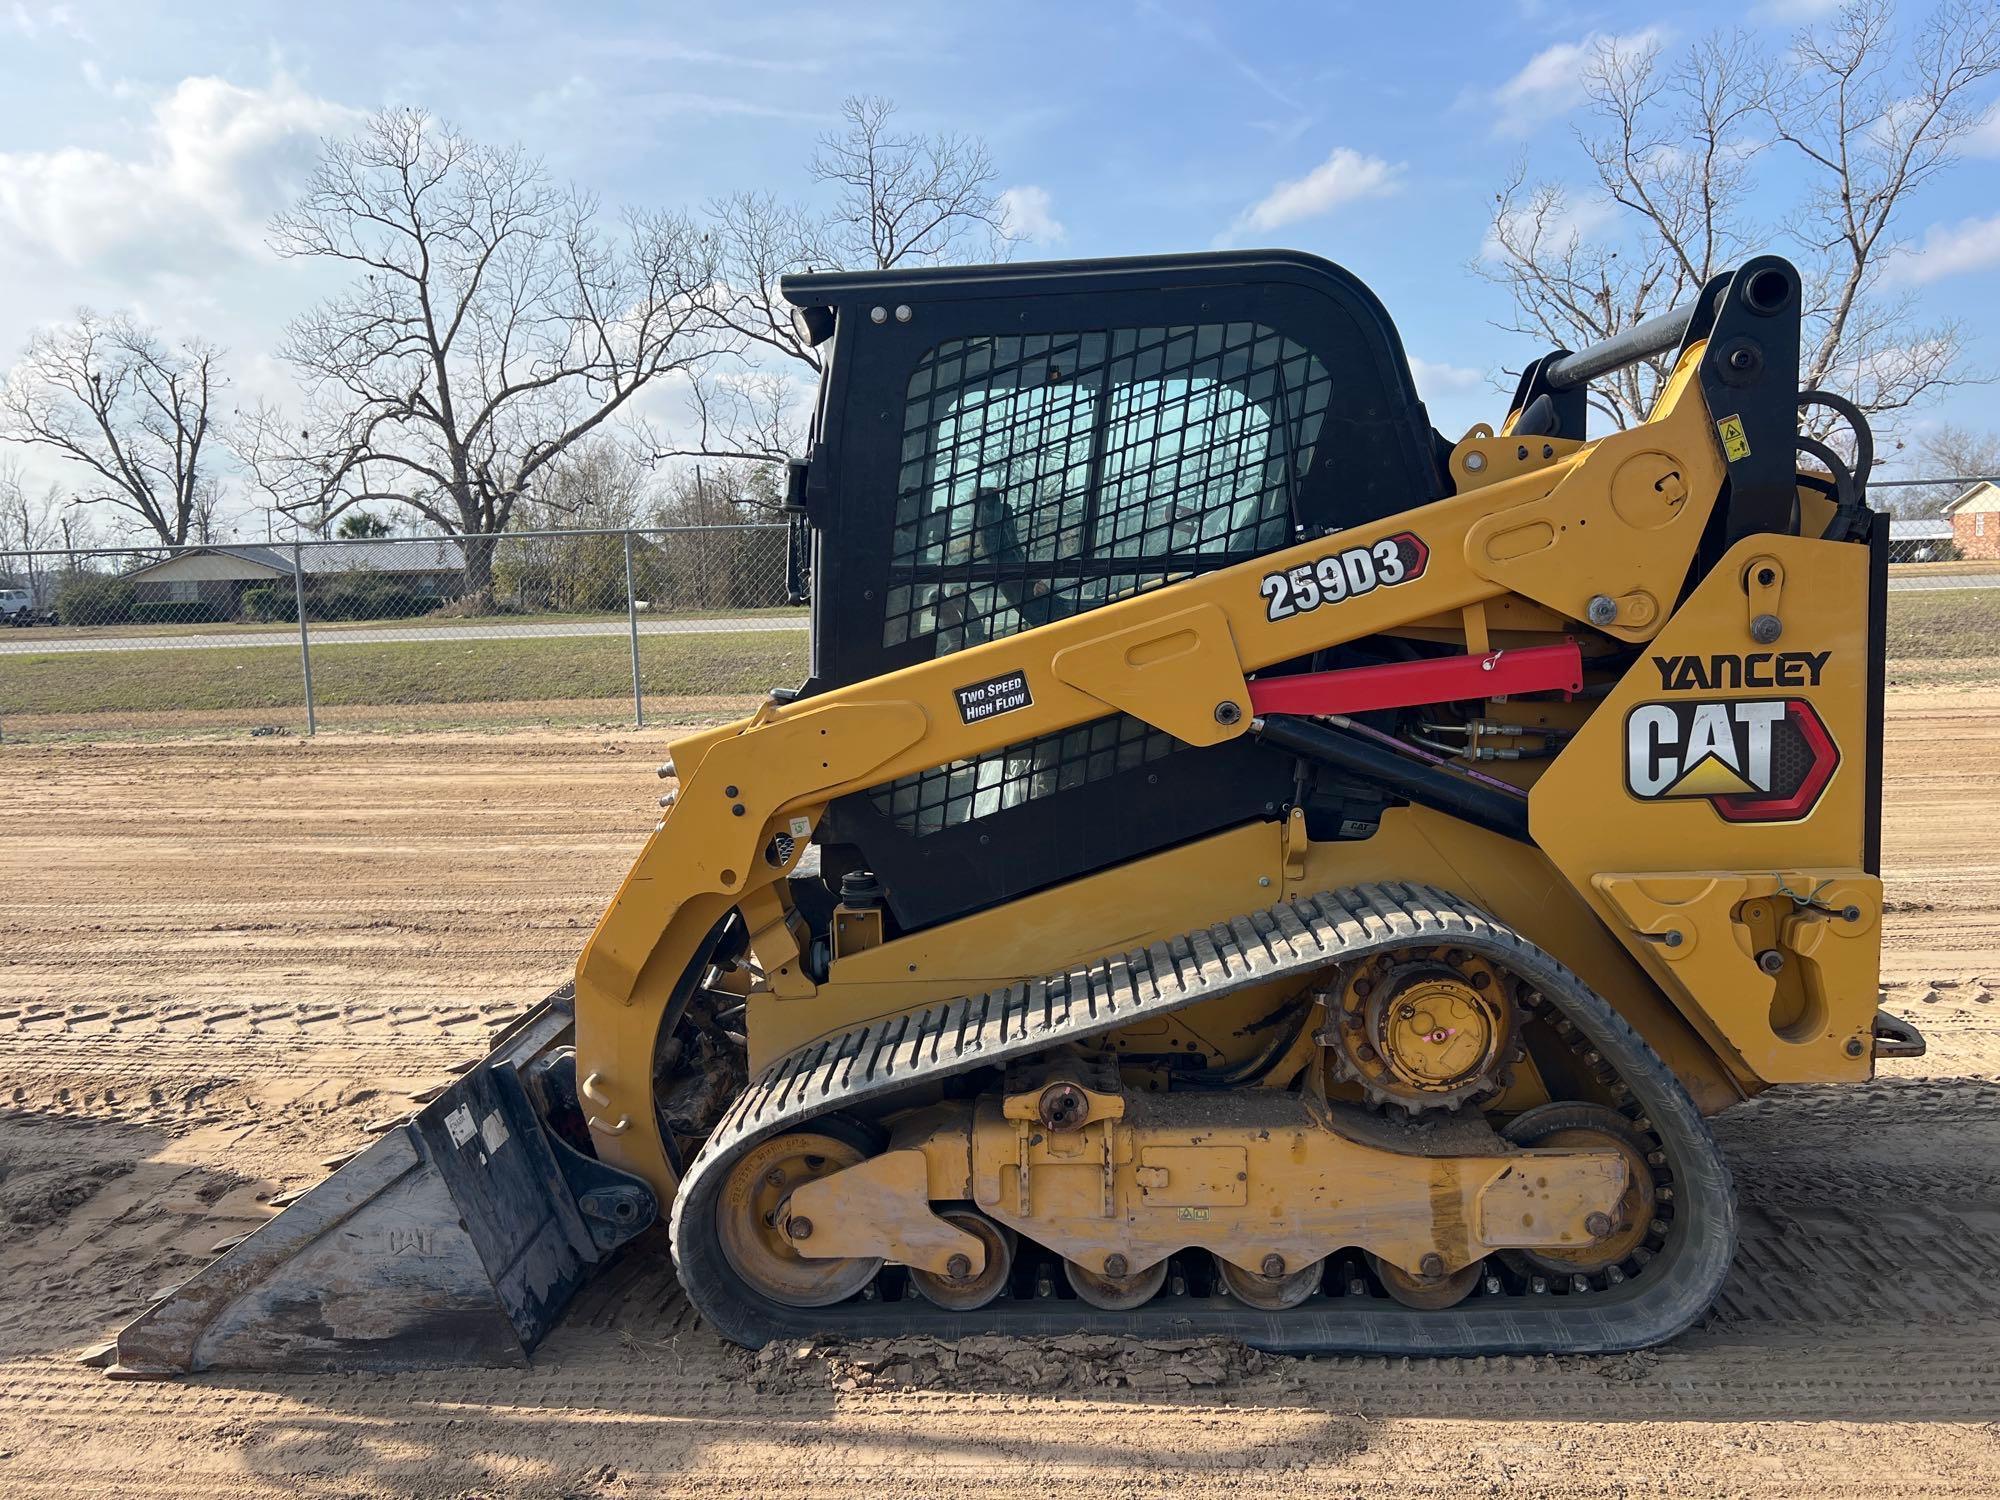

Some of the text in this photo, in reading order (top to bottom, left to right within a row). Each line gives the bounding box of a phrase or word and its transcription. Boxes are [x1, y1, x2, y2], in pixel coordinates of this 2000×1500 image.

[1262, 540, 1405, 620] 259D3
[987, 677, 1022, 697] SPEED
[1651, 651, 1833, 690] YANCEY
[966, 693, 1025, 720] HIGH FLOW
[1629, 701, 1785, 797] CAT
[1350, 822, 1369, 831] CAT
